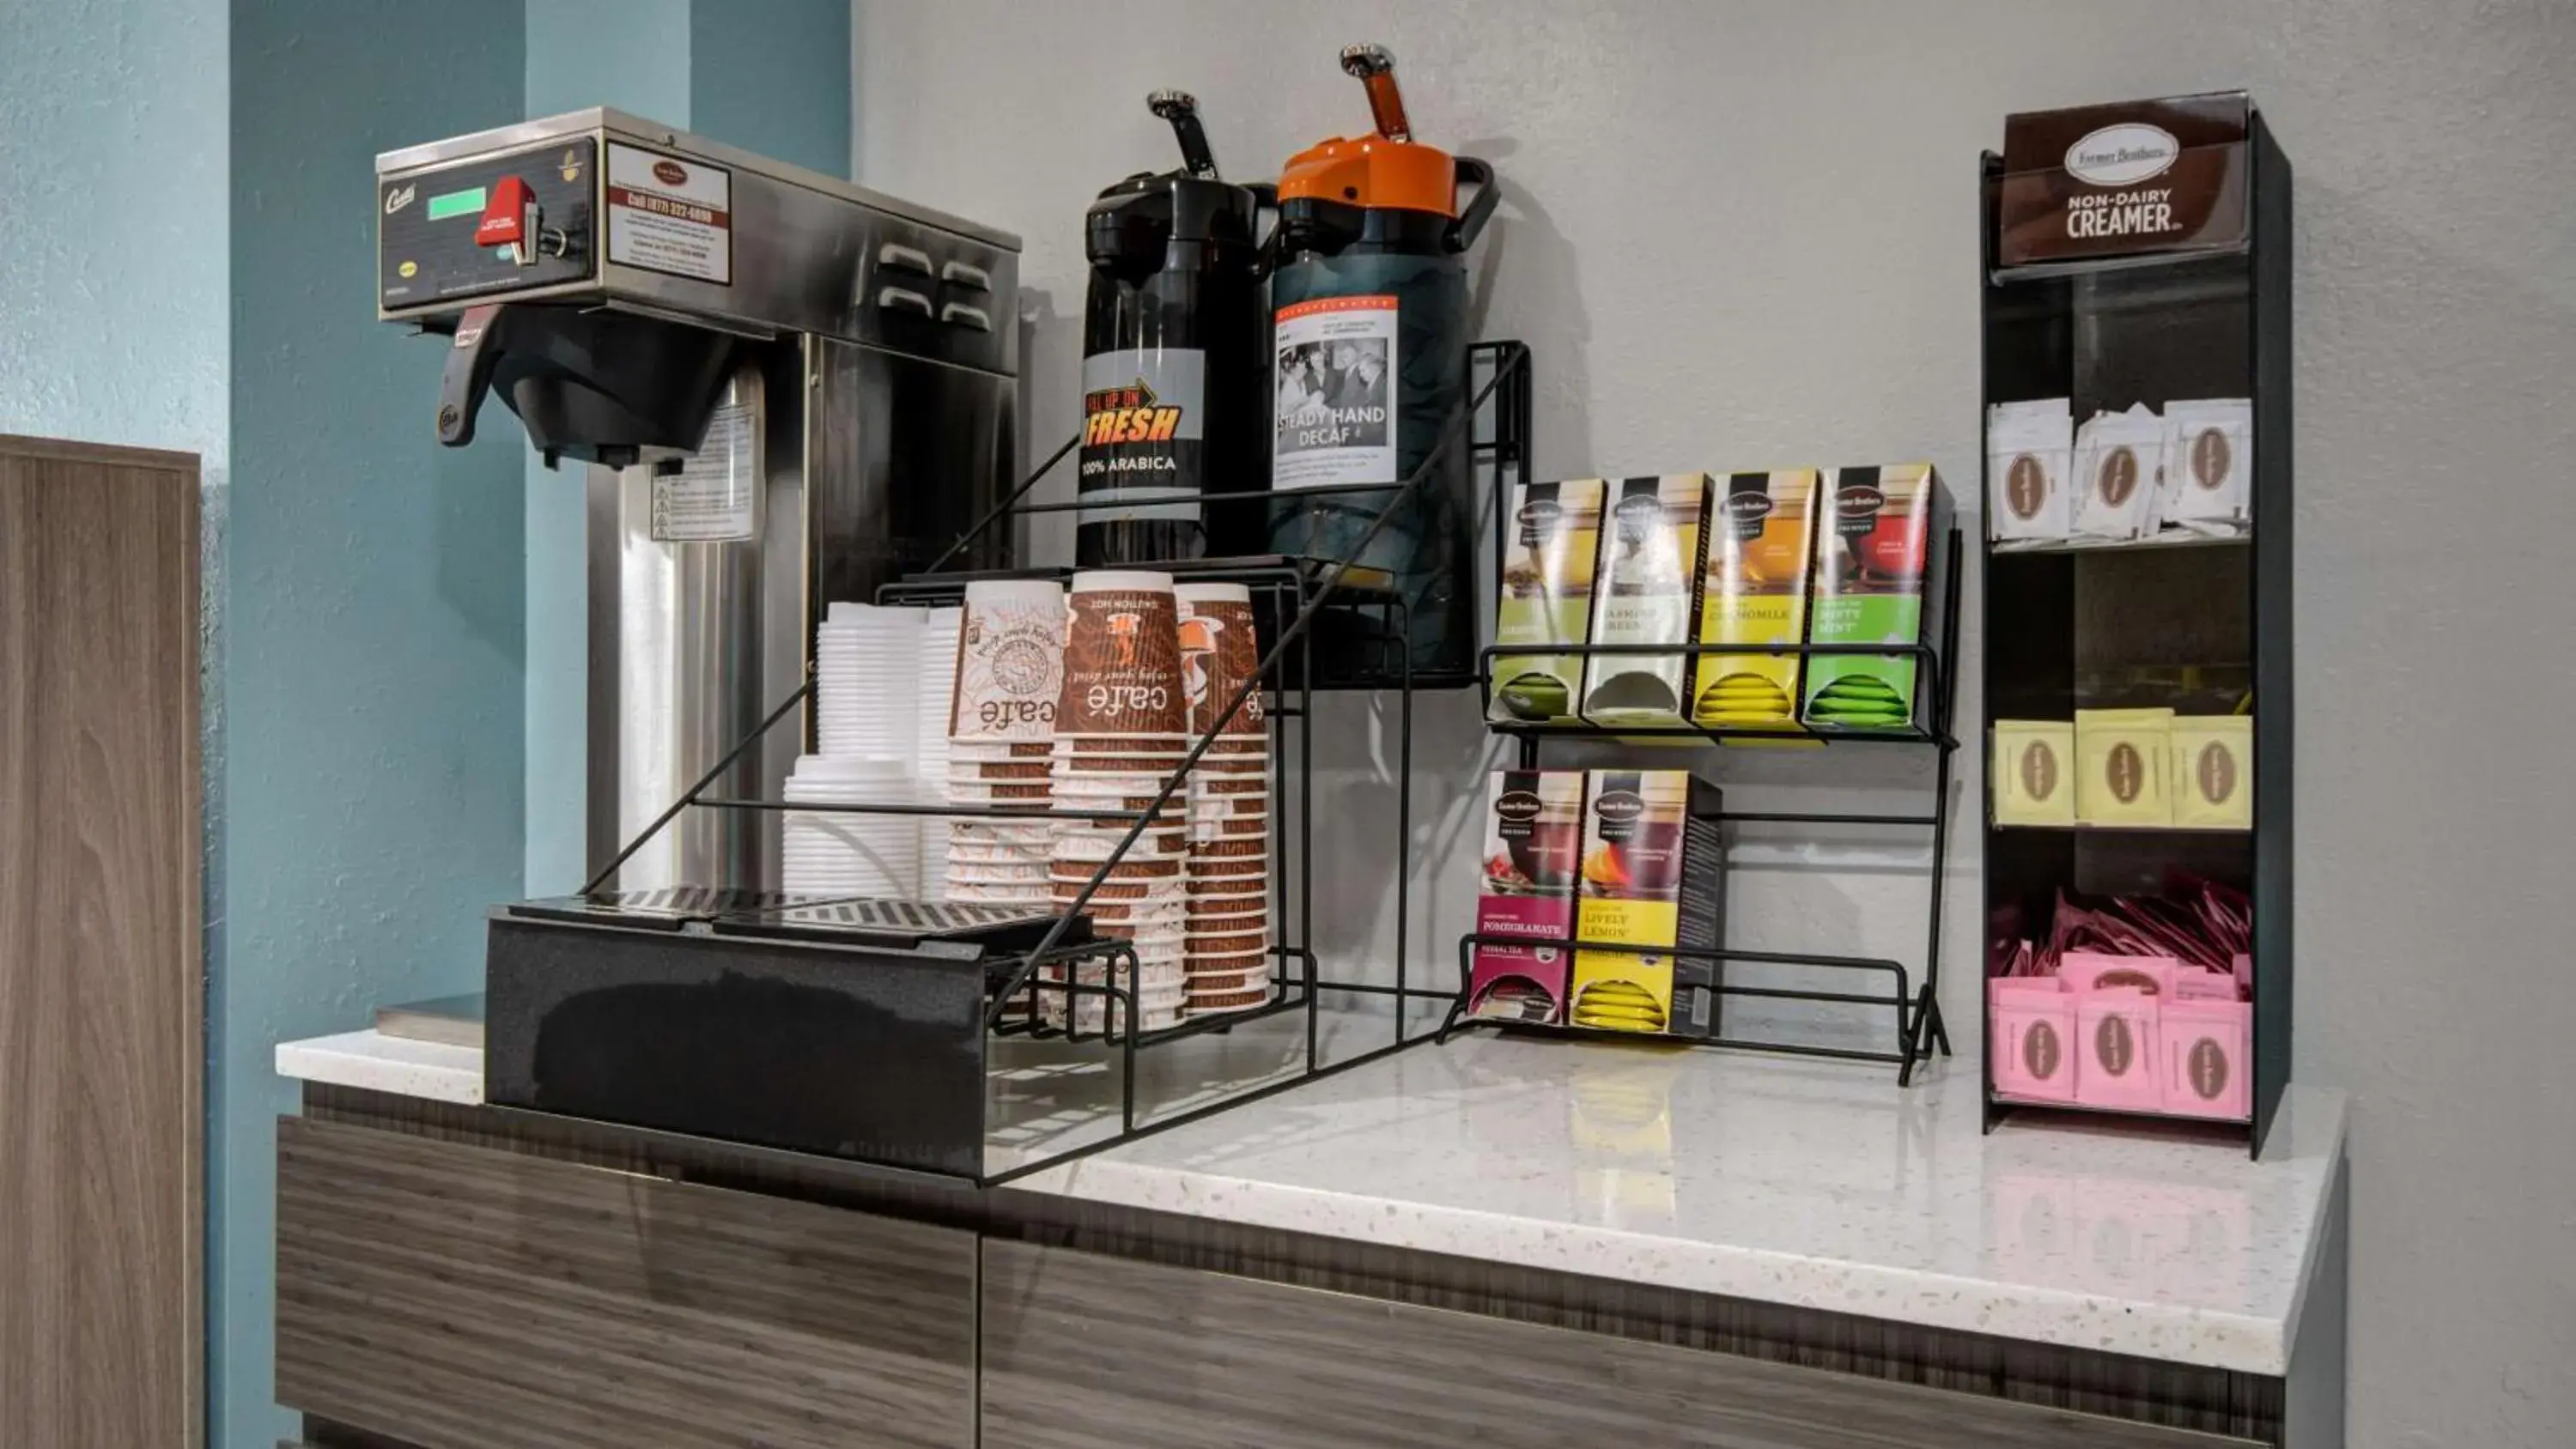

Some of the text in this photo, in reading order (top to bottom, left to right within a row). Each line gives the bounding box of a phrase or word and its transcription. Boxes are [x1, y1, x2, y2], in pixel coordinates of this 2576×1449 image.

[2068, 188, 2172, 209] NON-DAIRY
[2067, 203, 2172, 238] CREAMER
[1106, 391, 1119, 408] UP
[1123, 389, 1140, 407] ON
[1331, 405, 1386, 424] HAND
[1085, 408, 1182, 446] FRESH
[1298, 427, 1351, 446] DECAF
[1108, 456, 1176, 471] ARABICA
[1087, 685, 1168, 717] café
[980, 700, 1056, 731] café
[1584, 912, 1629, 925] LIVELY
[1583, 925, 1626, 938] LEMON
